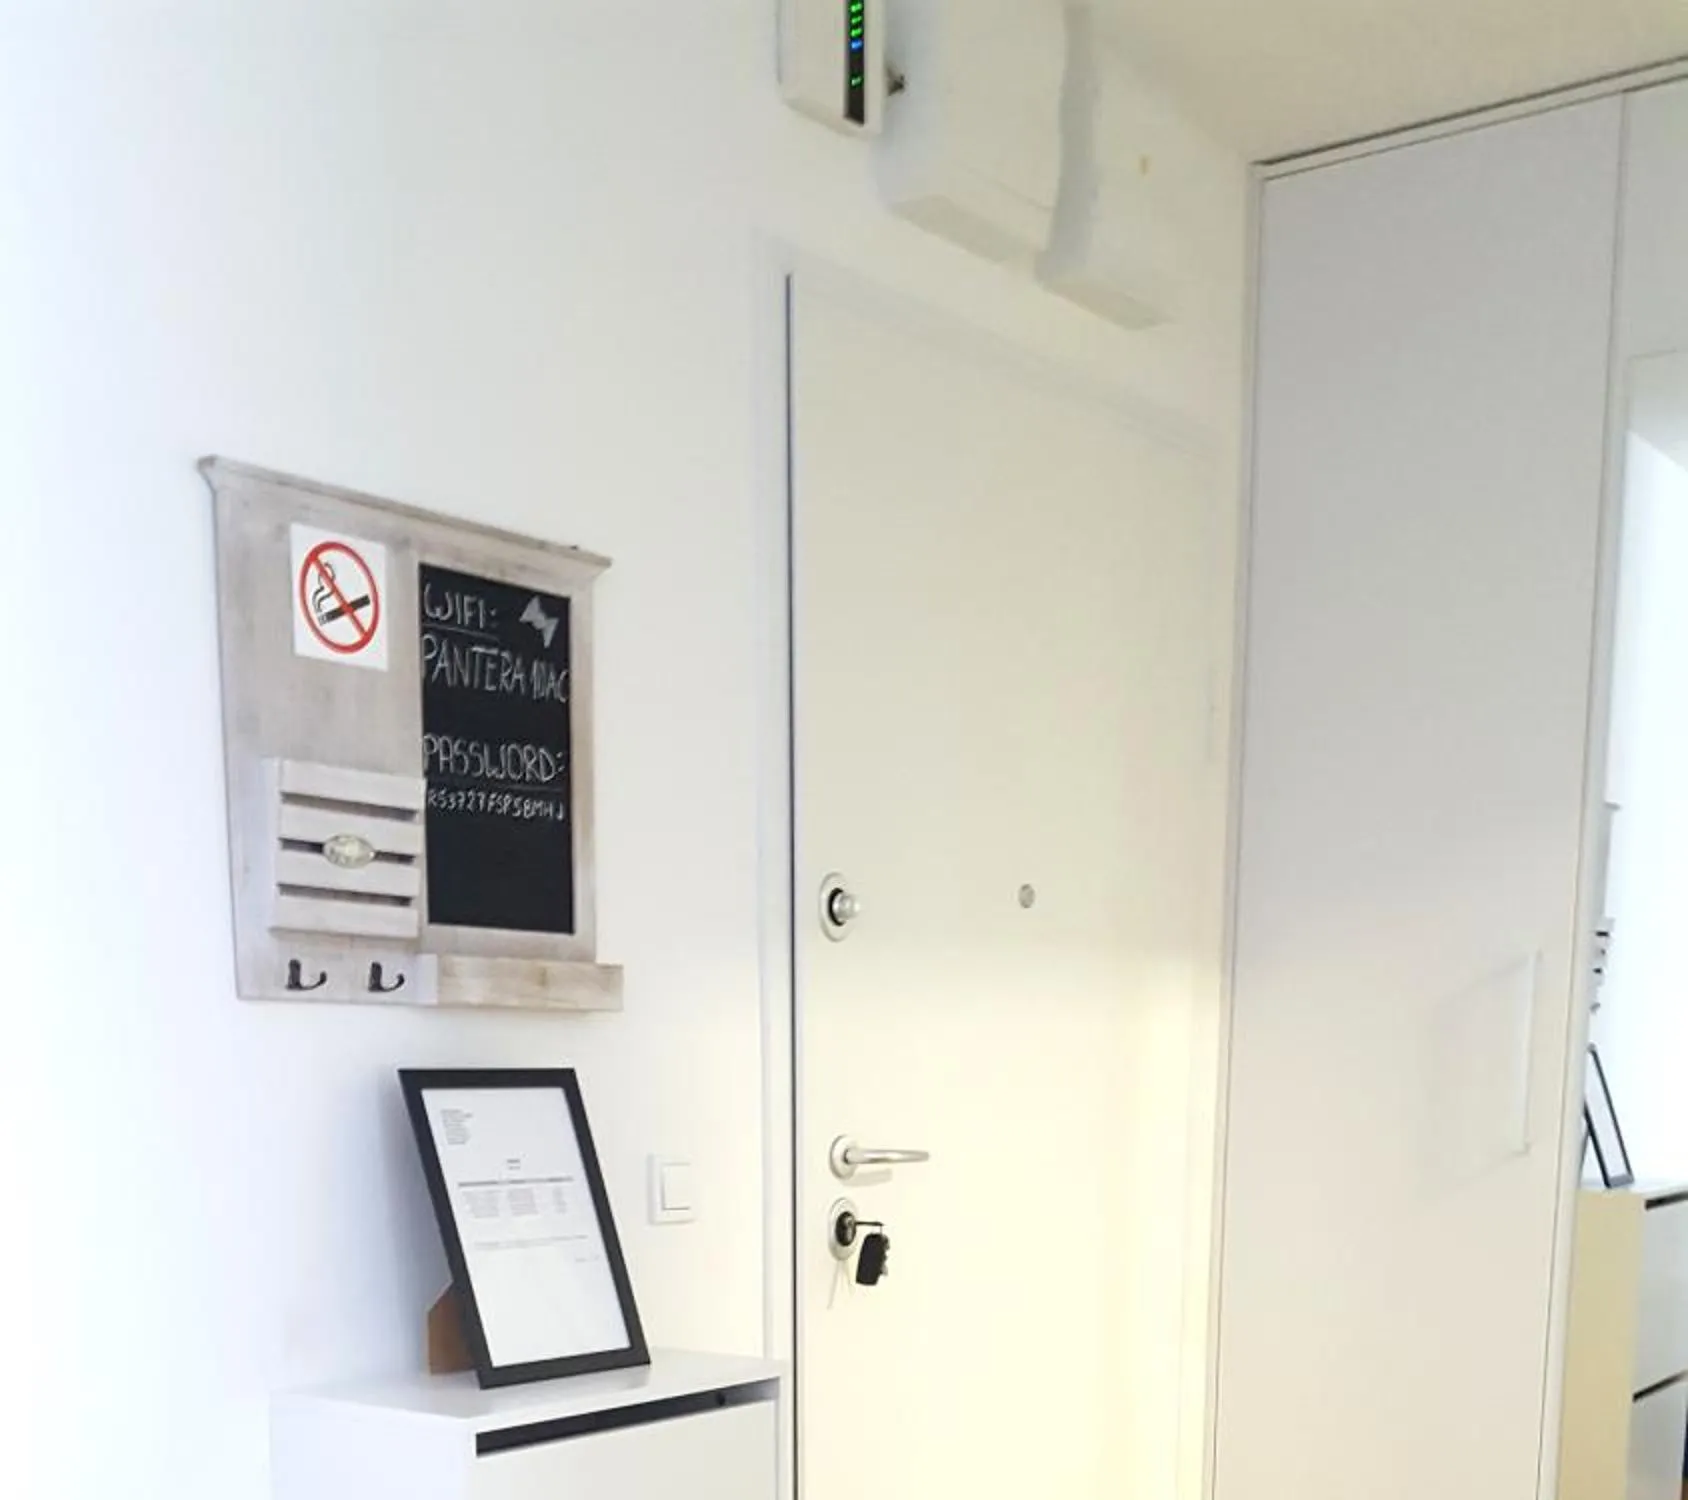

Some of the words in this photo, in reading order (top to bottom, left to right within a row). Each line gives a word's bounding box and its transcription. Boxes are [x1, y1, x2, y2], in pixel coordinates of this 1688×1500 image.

[424, 582, 497, 629] WIFI:
[421, 634, 525, 696] PANTERA
[422, 733, 565, 783] PASSWORD:
